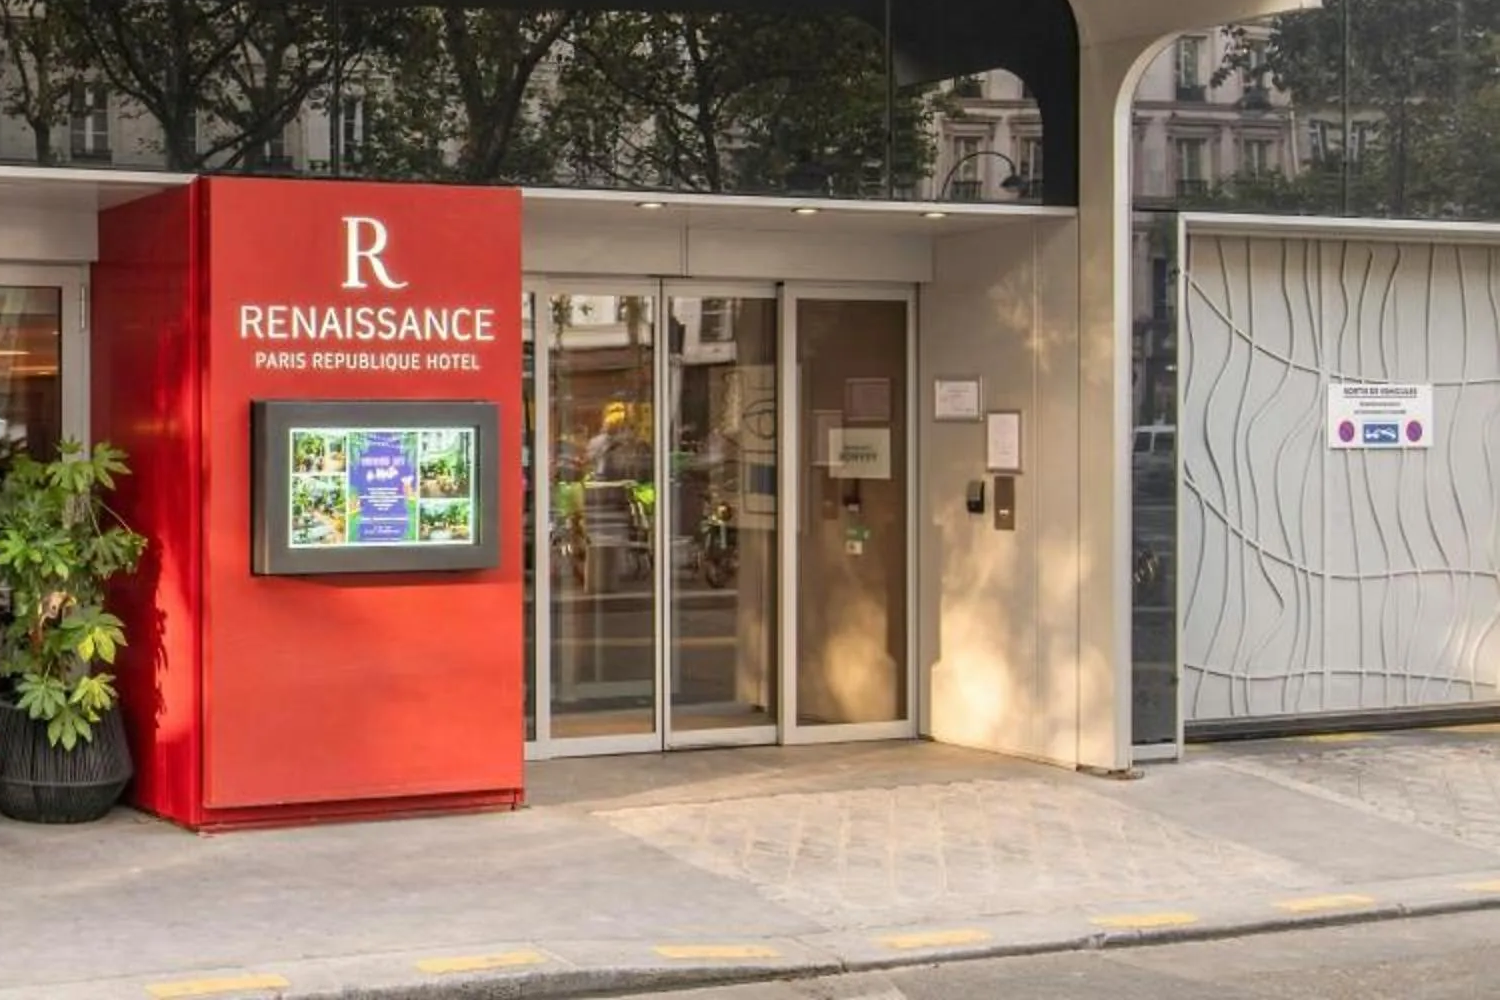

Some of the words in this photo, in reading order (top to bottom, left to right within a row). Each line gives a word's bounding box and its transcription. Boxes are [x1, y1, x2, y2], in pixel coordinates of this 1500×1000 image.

[341, 216, 409, 289] R
[239, 304, 496, 341] RENAISSANCE
[255, 351, 306, 369] PARIS
[312, 351, 421, 370] REPUBLIQUE
[427, 353, 480, 370] HOTEL
